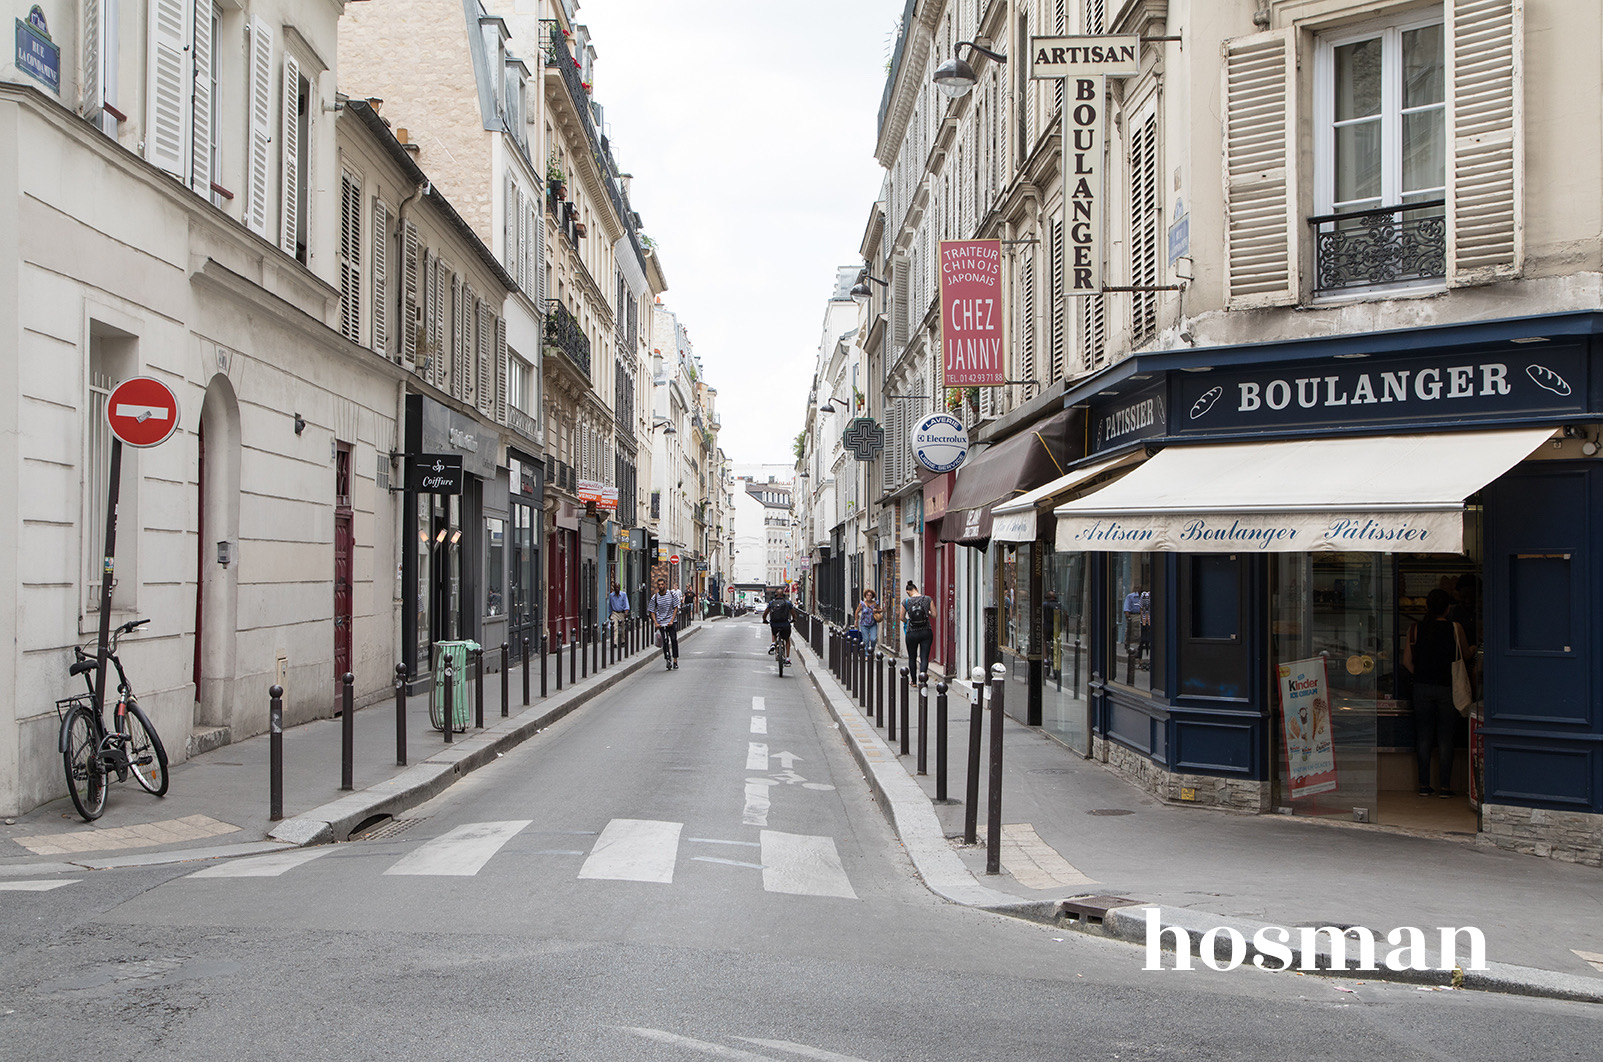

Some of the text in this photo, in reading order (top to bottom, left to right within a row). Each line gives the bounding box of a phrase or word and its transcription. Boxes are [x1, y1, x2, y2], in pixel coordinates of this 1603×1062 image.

[32, 40, 45, 59] RUE
[1034, 45, 1136, 65] ARTISAN
[1071, 79, 1097, 290] BOULANGER
[944, 246, 999, 261] TRAITEUR
[943, 259, 999, 274] CHINOIS
[948, 273, 996, 287] JAPONAIS
[951, 298, 994, 331] CHEZ
[947, 338, 1000, 371] JANNY
[960, 374, 968, 382] 01
[968, 374, 977, 382] 42
[977, 374, 986, 382] 93
[986, 373, 994, 381] 71
[994, 373, 1003, 381] 88
[1237, 363, 1512, 412] BOULANGER
[925, 416, 960, 429] LAVERIE
[1105, 398, 1155, 442] PATISSIER
[926, 434, 967, 443] Electrolux
[422, 475, 454, 489] Coiffure
[1075, 518, 1432, 550] Artisan Boulanger Pâtissier
